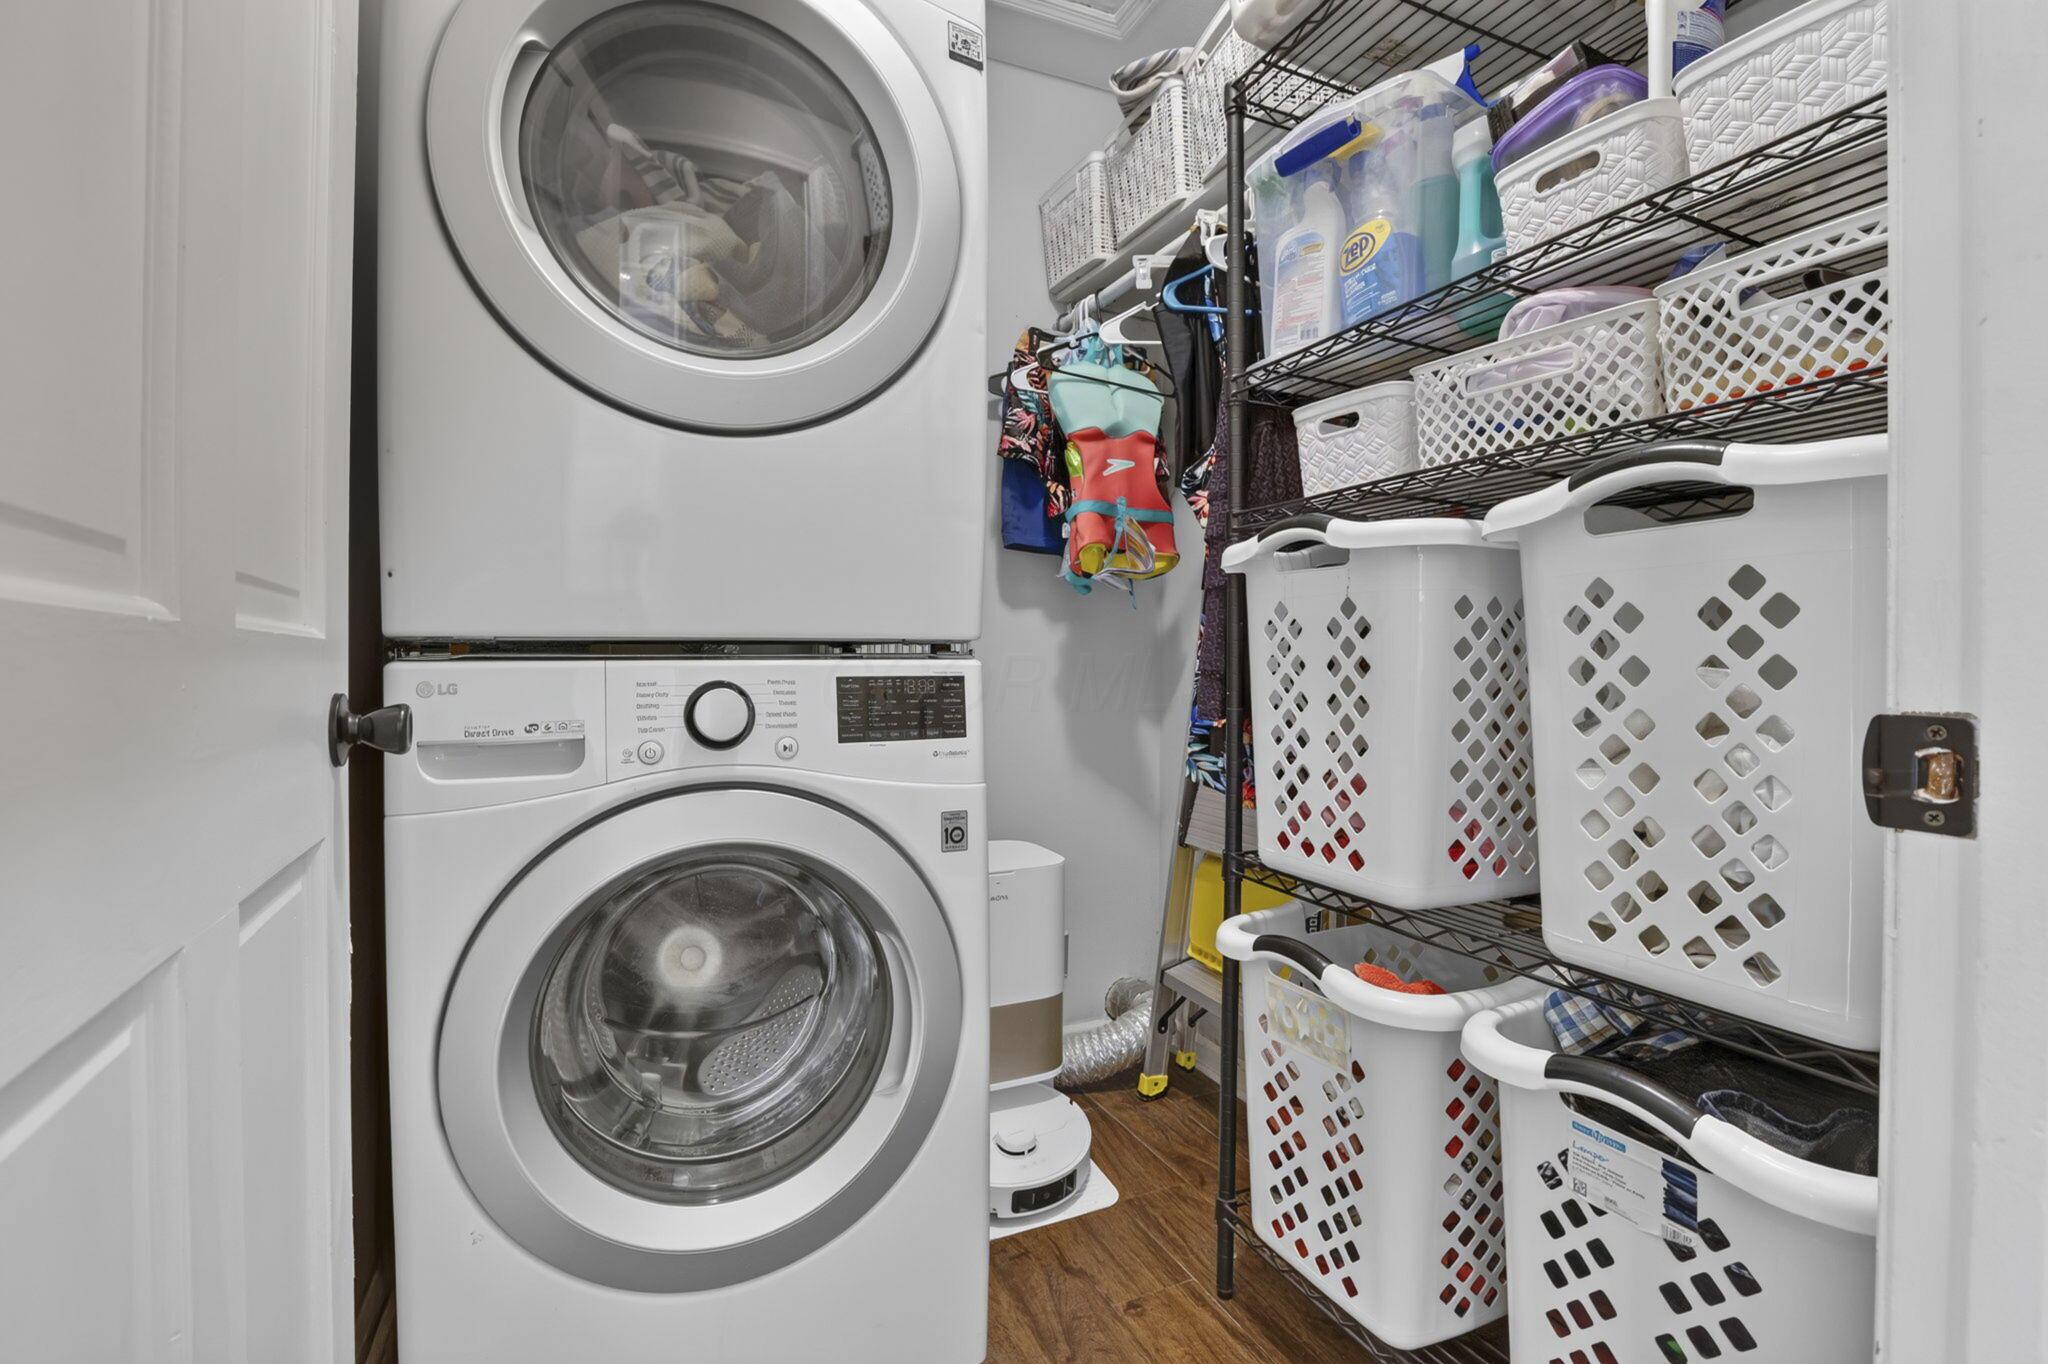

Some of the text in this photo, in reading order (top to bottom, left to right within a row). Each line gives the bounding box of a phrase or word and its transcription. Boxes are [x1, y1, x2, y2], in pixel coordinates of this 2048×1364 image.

[436, 683, 458, 696] LG
[464, 728, 515, 738] Direct Drive
[944, 826, 965, 844] 10
